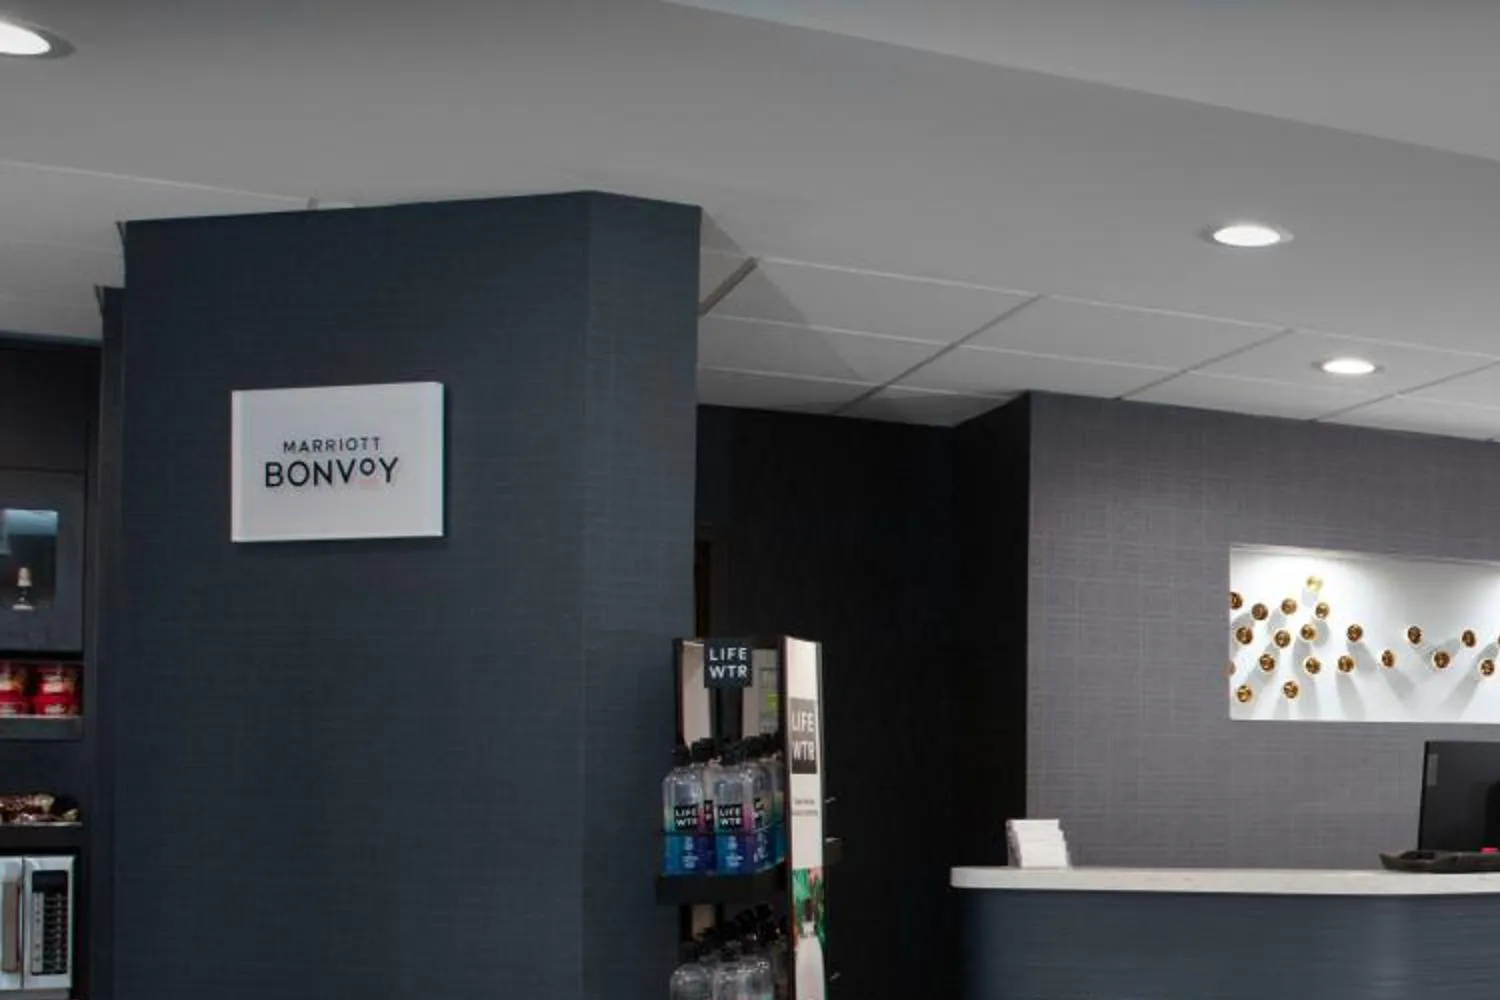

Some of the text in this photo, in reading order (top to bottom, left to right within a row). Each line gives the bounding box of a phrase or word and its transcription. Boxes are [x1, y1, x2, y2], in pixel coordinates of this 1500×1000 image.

[283, 436, 381, 454] MARRIOTT
[265, 456, 399, 488] BONVOY
[709, 647, 748, 662] LIFE
[709, 664, 748, 679] WTR
[791, 711, 815, 732] LIFE
[791, 740, 815, 761] WTR
[675, 807, 697, 817] LIFE
[719, 807, 741, 817] LIFE
[676, 817, 698, 827] WTR
[720, 817, 741, 826] WTR
